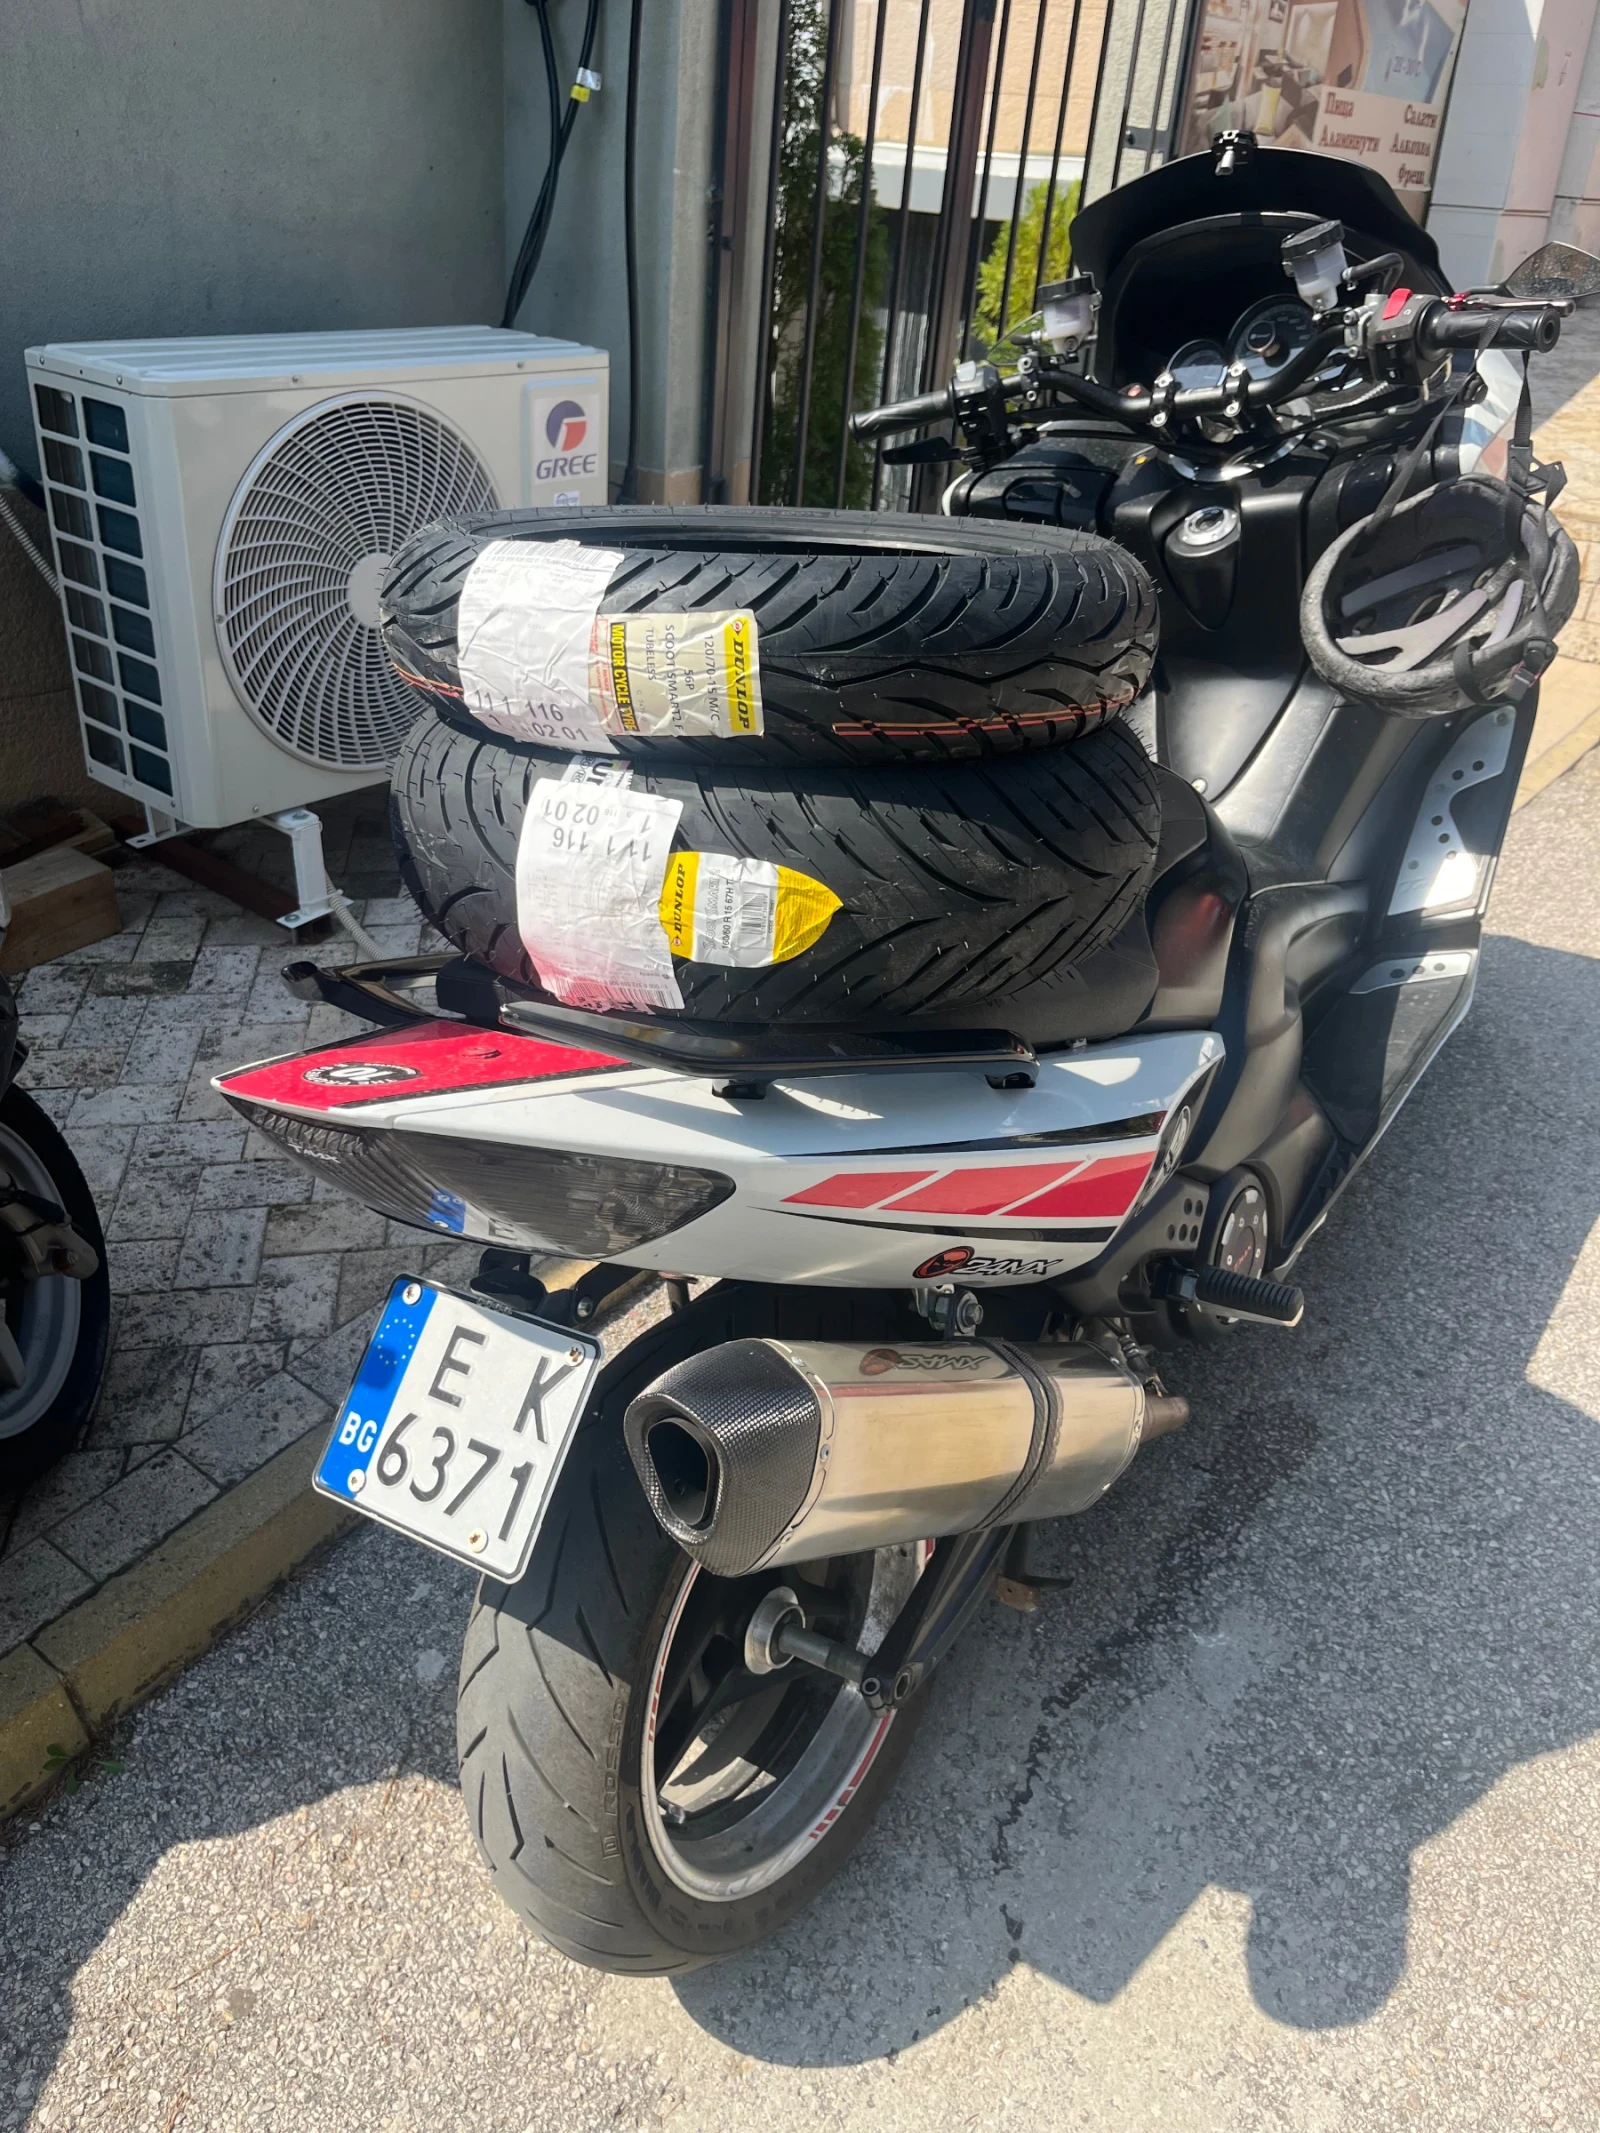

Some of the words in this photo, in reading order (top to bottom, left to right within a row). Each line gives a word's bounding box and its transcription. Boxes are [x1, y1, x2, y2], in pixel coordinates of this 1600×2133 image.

[1404, 104, 1438, 128] Салати
[536, 454, 597, 480] GREE
[611, 623, 625, 666] MOTOR
[645, 628, 657, 681] TUBELESS
[665, 624, 675, 668] SCOOT
[684, 669, 695, 691] 56P
[704, 635, 718, 695] 120/70-15
[613, 668, 628, 704] CYCLE
[732, 637, 750, 729] DUNLOP
[525, 701, 563, 721] 116
[619, 704, 637, 732] TYRE
[708, 696, 721, 721] M/C
[552, 827, 589, 851] 116
[673, 863, 687, 934] DUNLOP
[725, 888, 734, 904] 67H
[725, 905, 733, 917] 15
[722, 924, 732, 949] 160/60
[428, 1325, 485, 1408] E
[513, 1356, 575, 1444] K
[338, 1411, 378, 1453] BG
[376, 1412, 535, 1542] 6371
